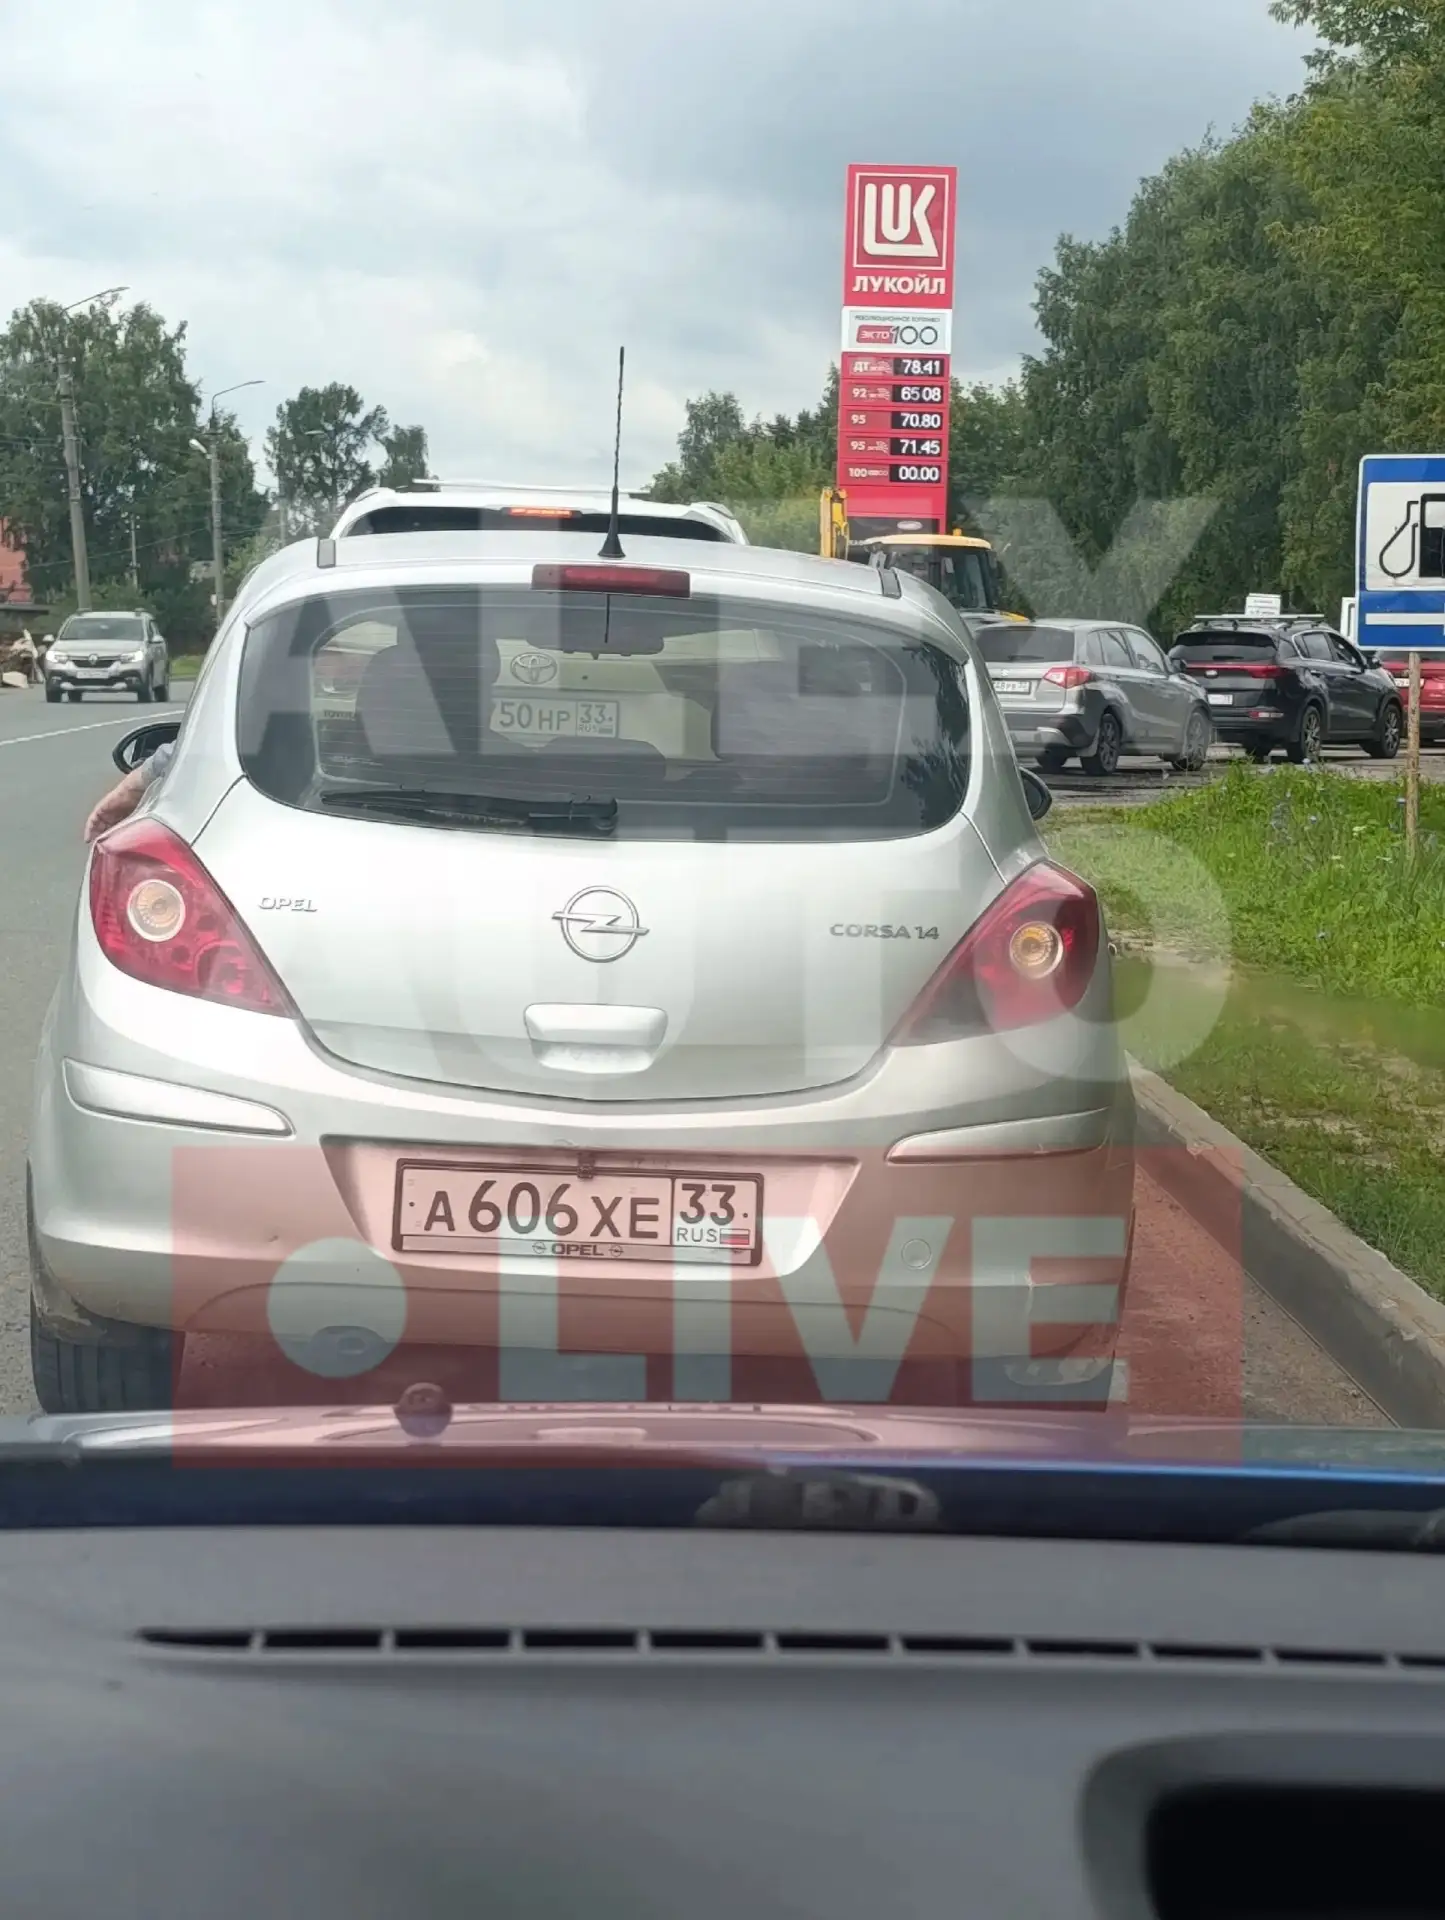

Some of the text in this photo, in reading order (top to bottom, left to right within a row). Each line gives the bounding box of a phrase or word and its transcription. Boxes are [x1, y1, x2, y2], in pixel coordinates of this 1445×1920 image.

[852, 273, 946, 295] ЛУКОЙЛ
[892, 325, 938, 345] 100
[853, 361, 869, 373] ДТ
[852, 388, 867, 398] 92
[851, 413, 941, 428] 95 70.80
[851, 441, 866, 451] 95
[900, 439, 940, 455] 71.45
[848, 468, 867, 477] 100
[898, 466, 939, 480] 00.00
[580, 703, 606, 724] 33
[259, 897, 318, 912] OPEL
[829, 924, 911, 939] CORSA
[680, 1183, 736, 1226] 33
[677, 1227, 717, 1244] RUS
[551, 1243, 604, 1257] OPEL
